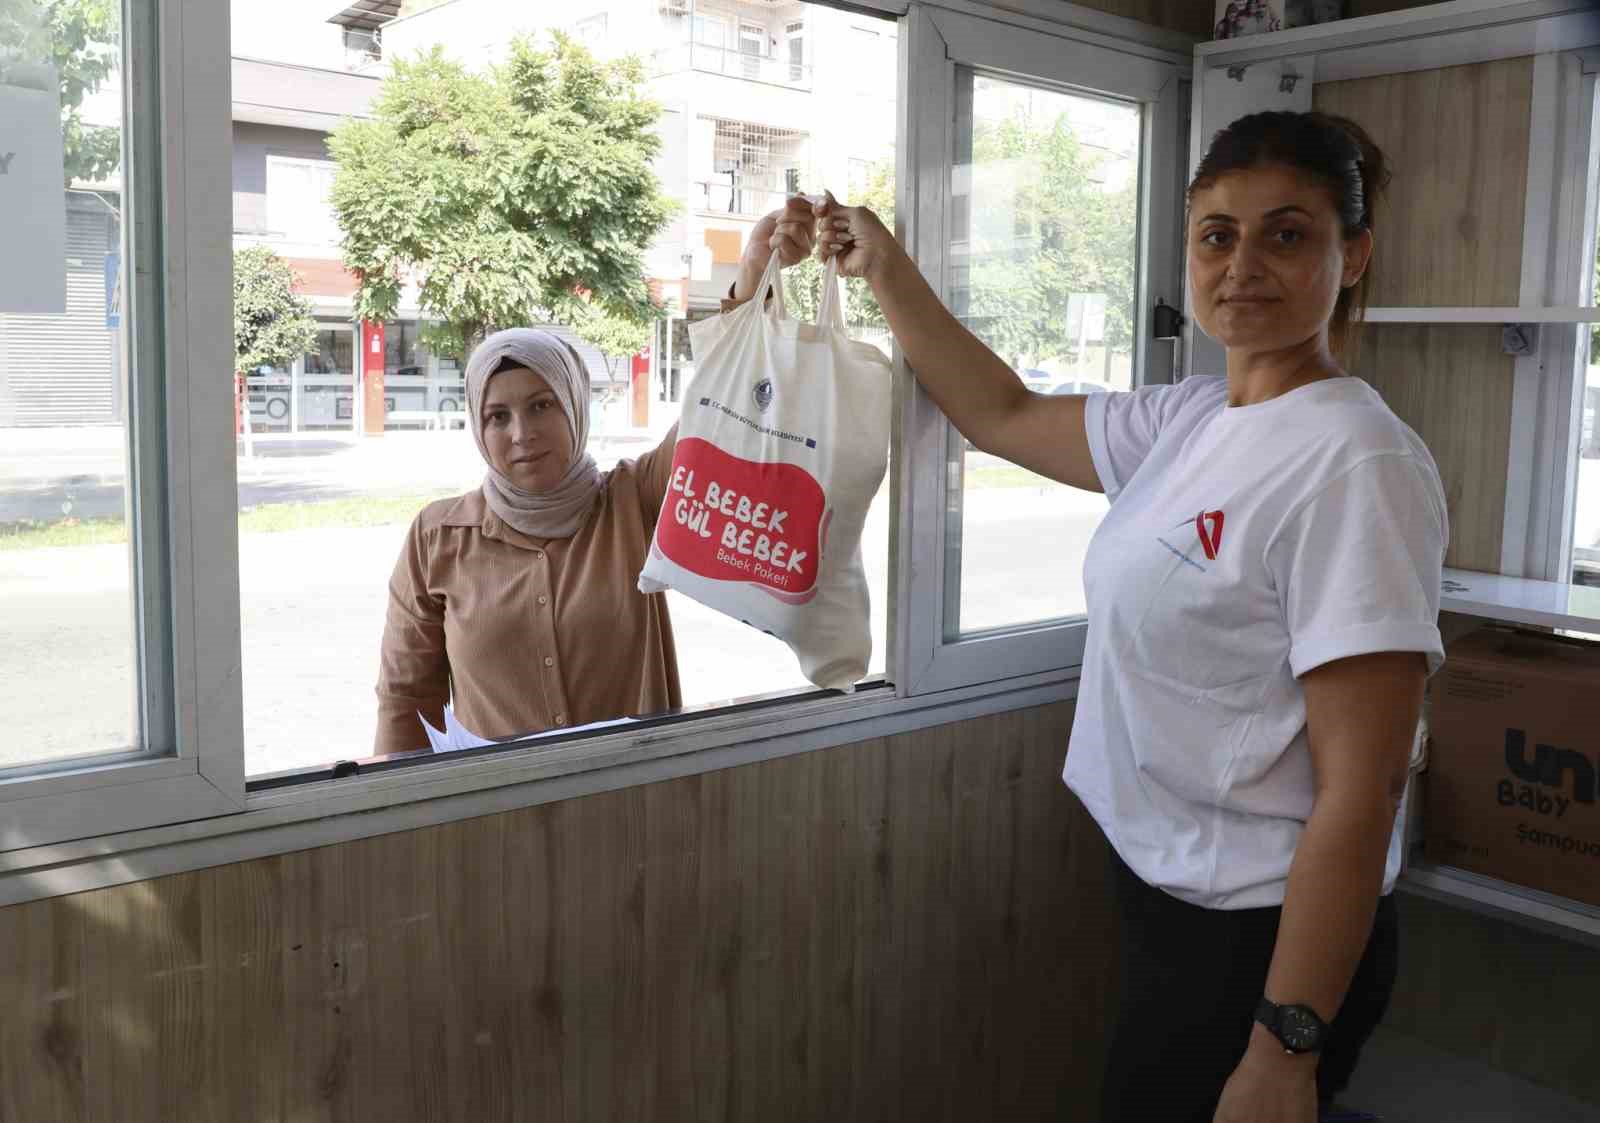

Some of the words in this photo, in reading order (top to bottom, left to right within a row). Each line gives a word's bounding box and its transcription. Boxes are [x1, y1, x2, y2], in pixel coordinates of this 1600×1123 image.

[672, 465, 695, 497] EL
[705, 481, 788, 534] BEBEK
[675, 498, 712, 538] GÜL
[721, 521, 807, 574] BEBEK
[716, 548, 751, 572] Bebek
[754, 562, 789, 586] Paketi
[1497, 778, 1569, 819] Baby
